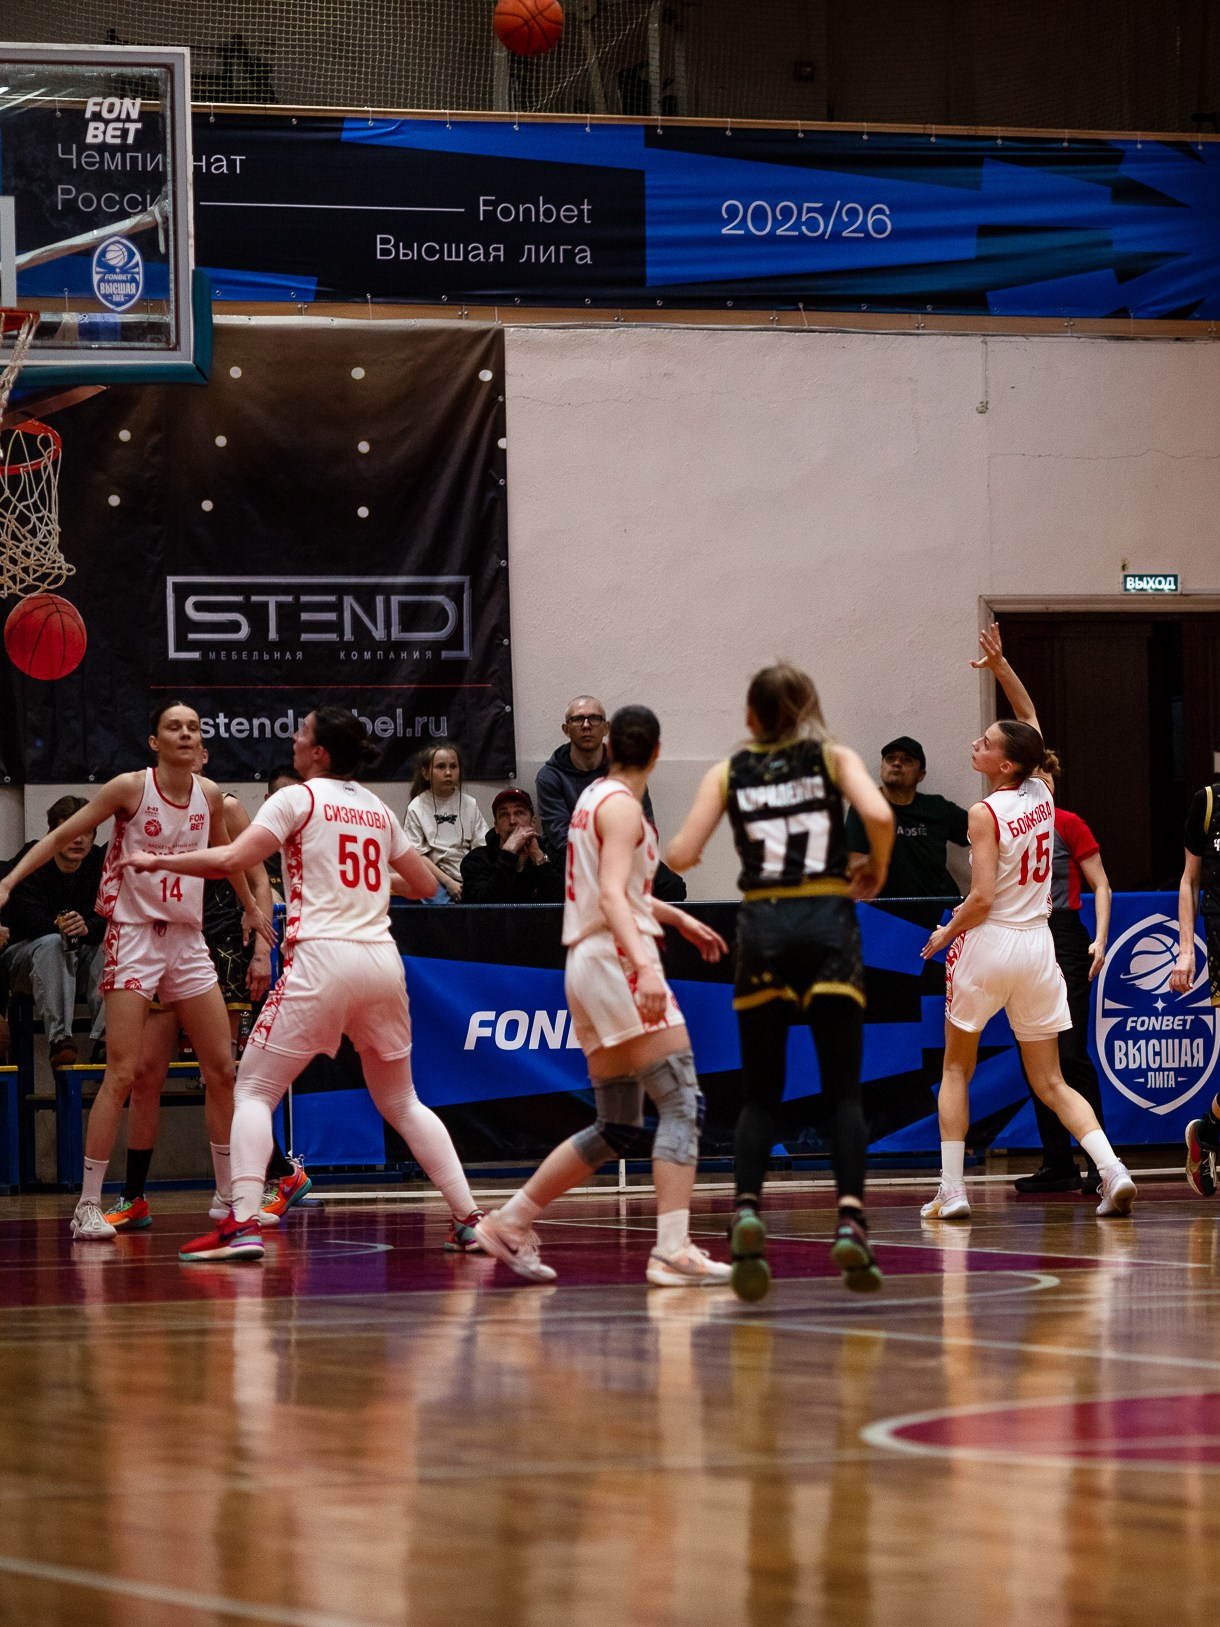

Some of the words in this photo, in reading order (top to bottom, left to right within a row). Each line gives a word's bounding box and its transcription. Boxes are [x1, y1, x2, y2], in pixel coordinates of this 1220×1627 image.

[85, 97, 142, 119] FON
[85, 122, 143, 144] BET
[57, 143, 247, 175] Чемпинат
[479, 195, 593, 225] Fonbet
[720, 199, 893, 240] 2025/26
[375, 233, 505, 263] Высшая
[518, 244, 594, 266] лига
[99, 282, 136, 294] ВЫСШАЯ
[1126, 576, 1176, 590] ВЫХОД
[184, 594, 459, 642] STEND
[208, 650, 304, 662] МЕБЕЛЬНАЯ
[339, 649, 433, 661] КОМПАНИЯ
[189, 813, 205, 823] FON
[189, 822, 205, 832] BET
[323, 803, 387, 831] СИЗЯКОВА
[1007, 800, 1052, 839] БОЙКОВА
[338, 833, 382, 892] 58
[1018, 831, 1050, 886] 15
[160, 876, 183, 903] 14
[1126, 1015, 1195, 1031] FONBET
[1113, 1037, 1204, 1070] ВЫСШАЯ
[1147, 1071, 1176, 1089] ЛИГА
